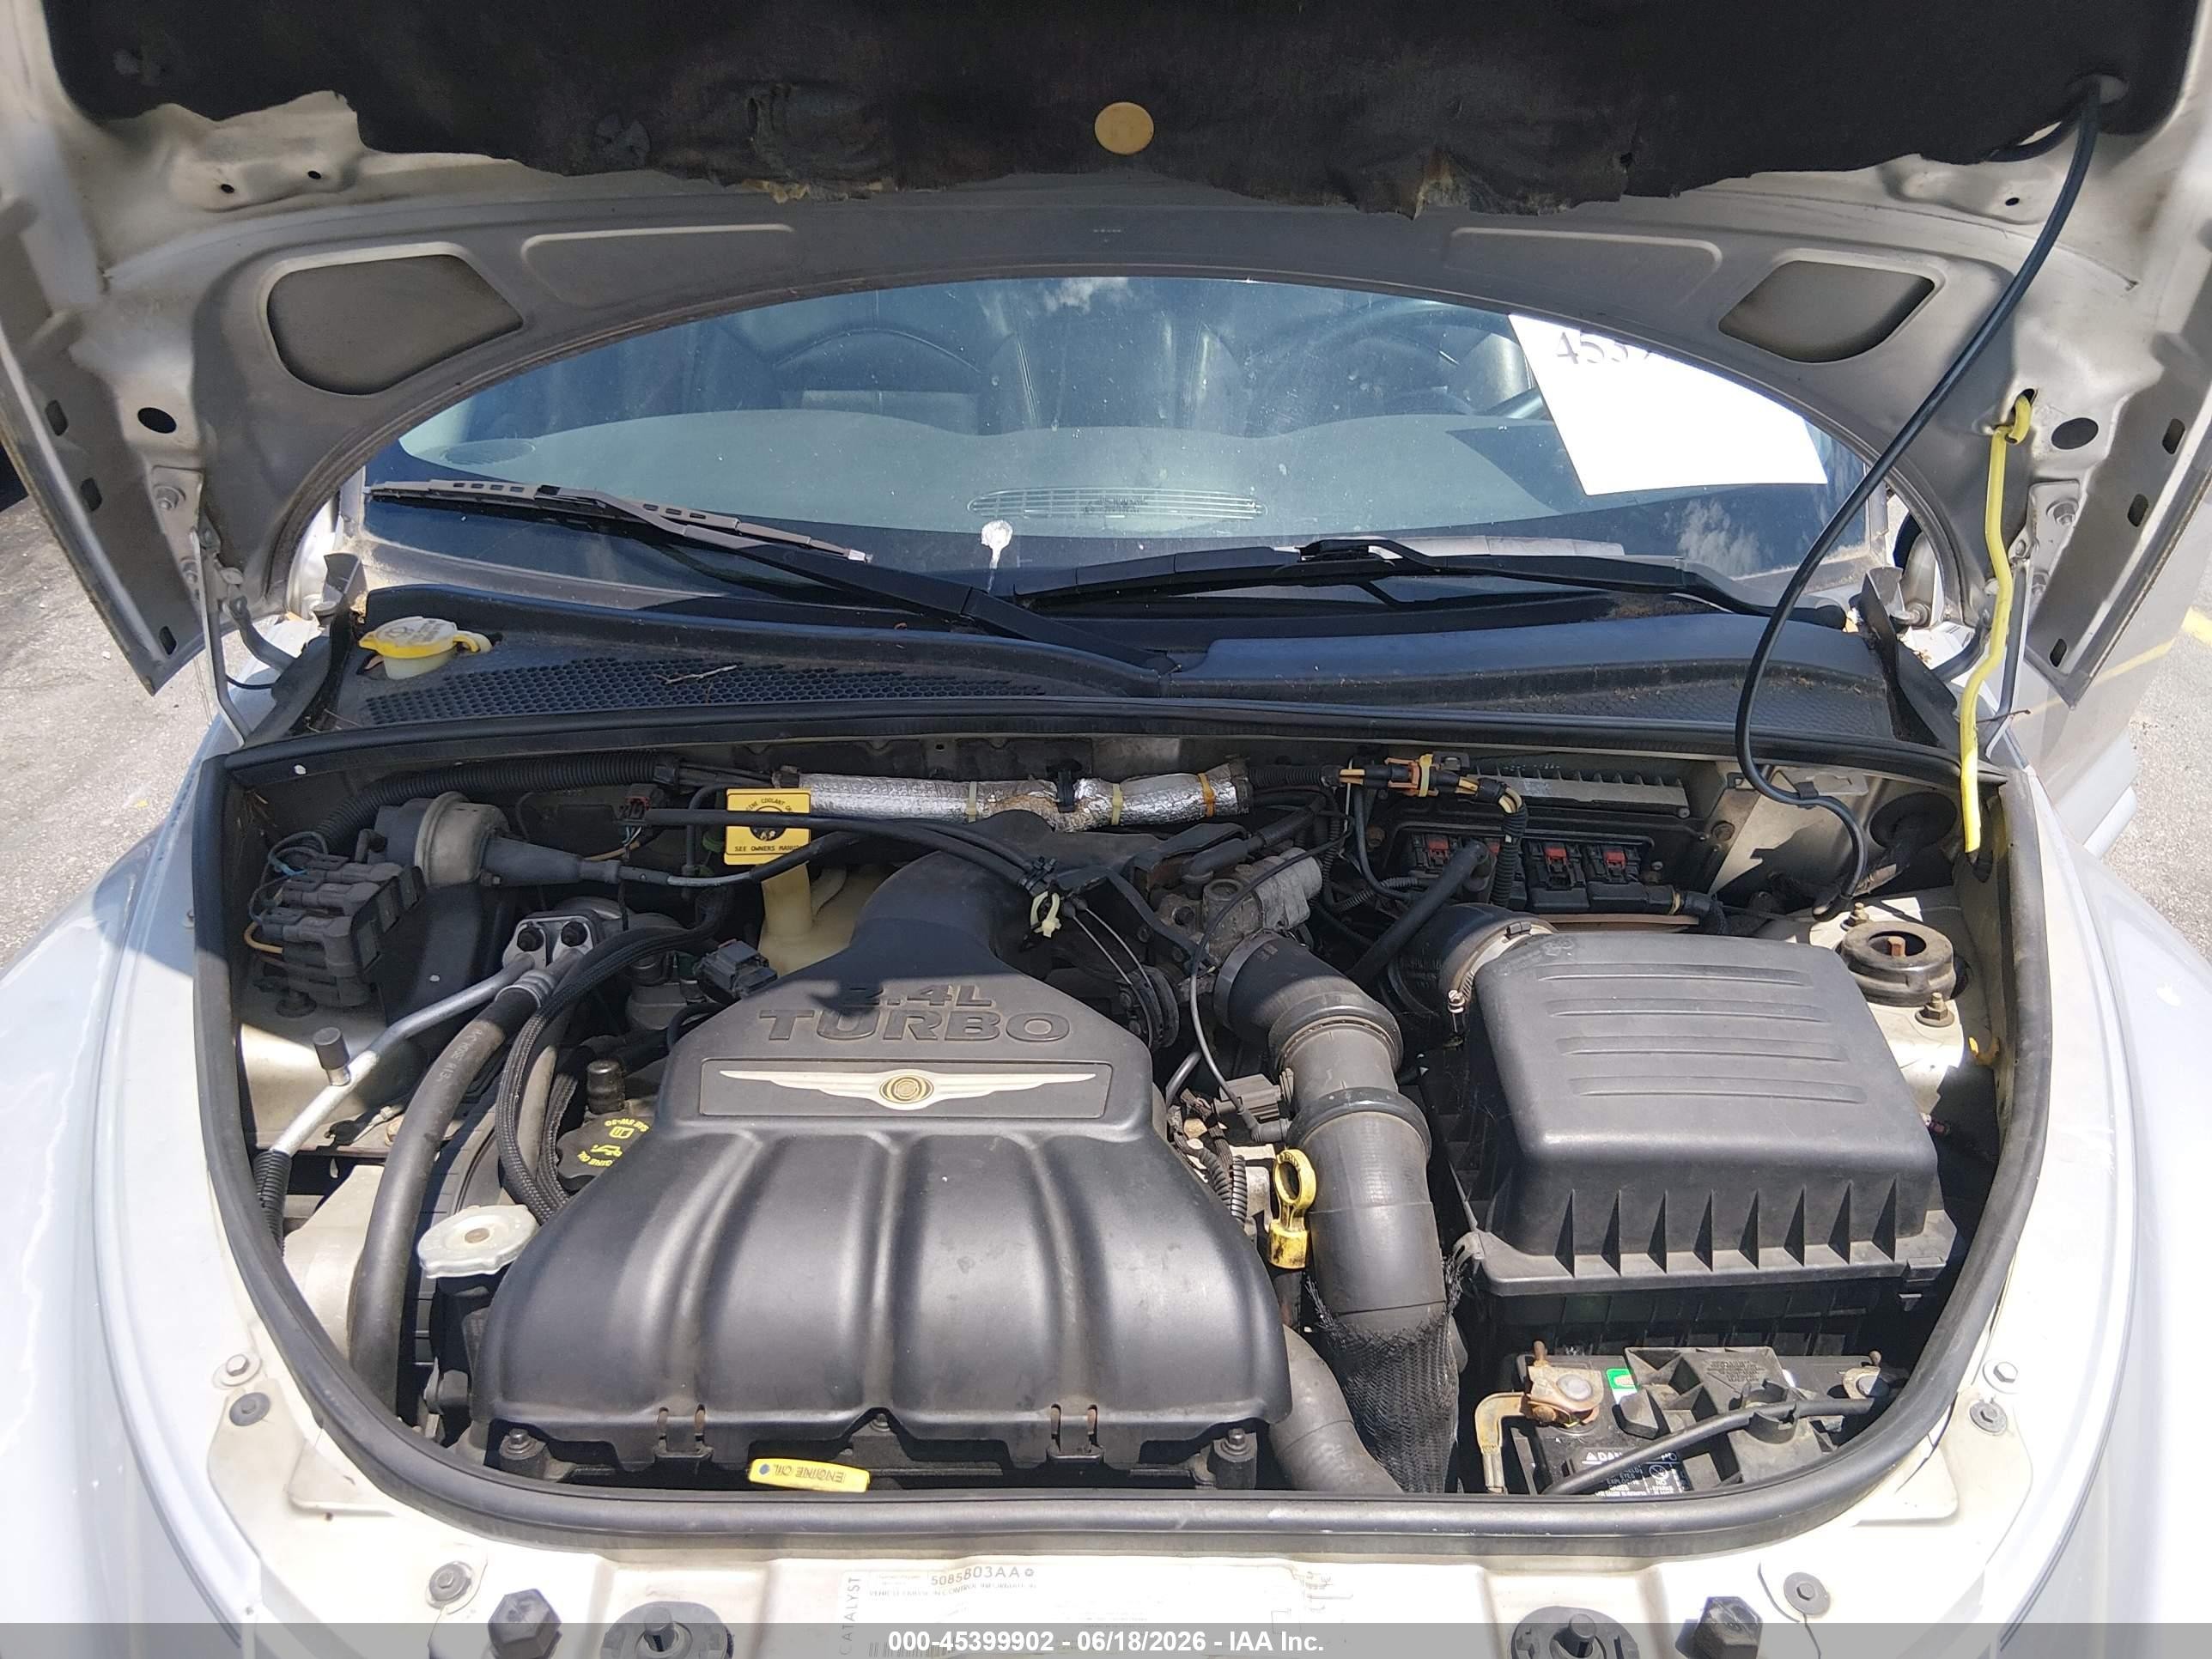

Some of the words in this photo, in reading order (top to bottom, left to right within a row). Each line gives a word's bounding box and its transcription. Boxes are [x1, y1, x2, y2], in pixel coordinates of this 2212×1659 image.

[843, 982, 994, 1008] 2.4L
[759, 1009, 1070, 1042] TURBO
[774, 1463, 793, 1476] OIL
[795, 1466, 845, 1483] ENGINE
[931, 1565, 1021, 1586] 5085803AA
[839, 1577, 861, 1656] CATALYST
